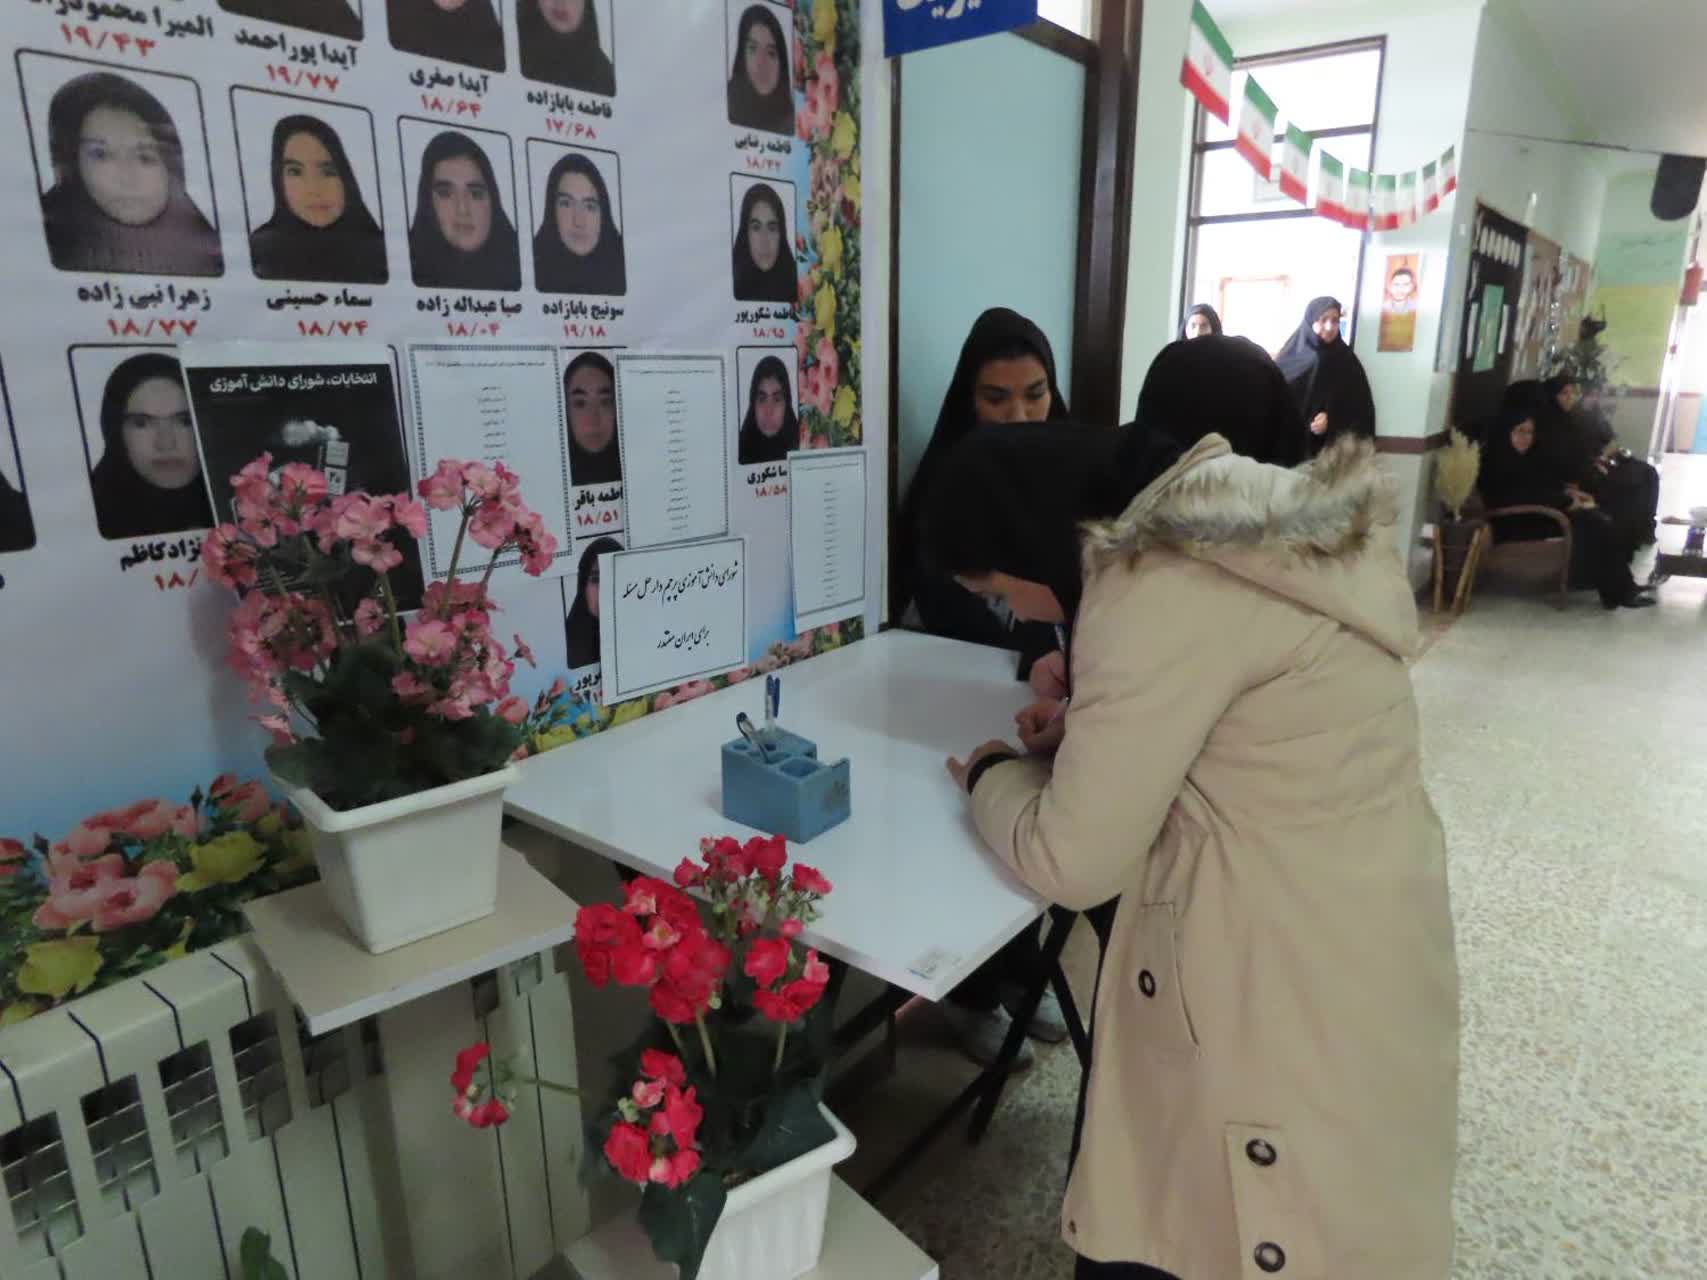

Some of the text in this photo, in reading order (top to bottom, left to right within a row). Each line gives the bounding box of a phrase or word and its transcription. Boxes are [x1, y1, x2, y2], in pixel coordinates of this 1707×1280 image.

[266, 64, 339, 93] ۱۹/۷۷
[577, 99, 613, 119] فاطمه
[169, 284, 212, 312] زهرا
[266, 288, 329, 311] حسینی
[107, 317, 198, 338] ۱۸/۷۷
[297, 319, 369, 338] ۱۸/۷۴
[562, 323, 607, 339] ۱۹/۱۸
[208, 372, 249, 393] آموزی
[250, 373, 287, 393] دانش
[287, 373, 325, 390] شورای
[597, 486, 624, 502] اطمه
